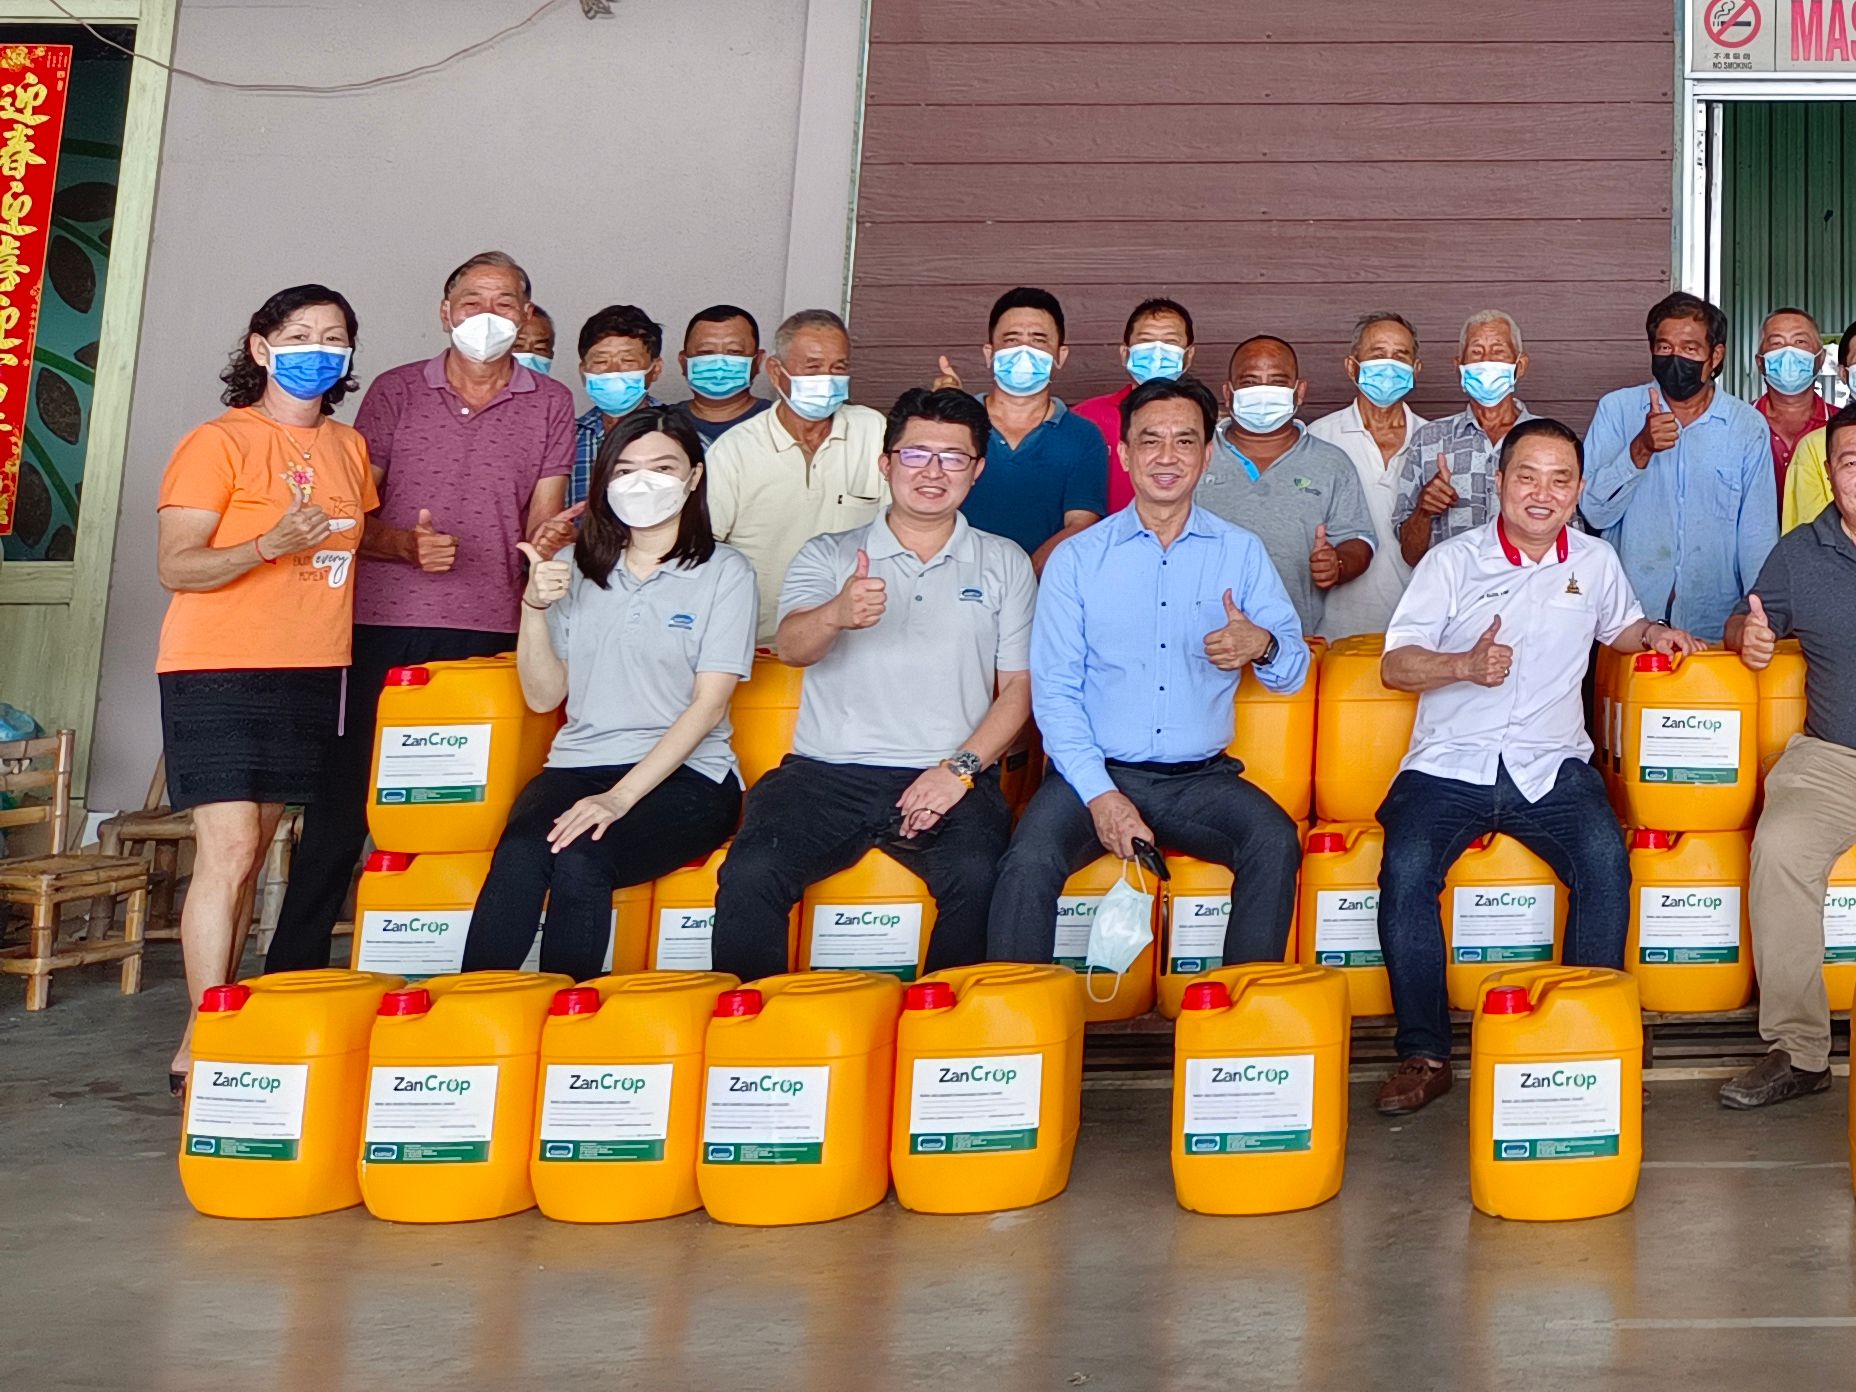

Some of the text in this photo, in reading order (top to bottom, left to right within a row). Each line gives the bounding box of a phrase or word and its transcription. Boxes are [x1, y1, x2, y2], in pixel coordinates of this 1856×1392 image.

[1712, 61, 1752, 69] NO SMOKING
[1661, 715, 1723, 733] ZanCrop
[402, 732, 469, 749] ZanCrop
[1474, 892, 1538, 909] ZanCrop
[1661, 893, 1723, 911] ZanCrop
[382, 917, 450, 935] ZanCrop
[834, 911, 901, 928] ZanCrop
[213, 1071, 281, 1094] ZanCrop
[570, 1073, 646, 1094] ZanCrop
[939, 1065, 1017, 1085] ZanCrop
[1211, 1064, 1290, 1086] ZanCrop
[1520, 1070, 1597, 1090] ZanCrop
[394, 1074, 471, 1096] ZanCrop
[729, 1074, 804, 1097] ZanCrop
